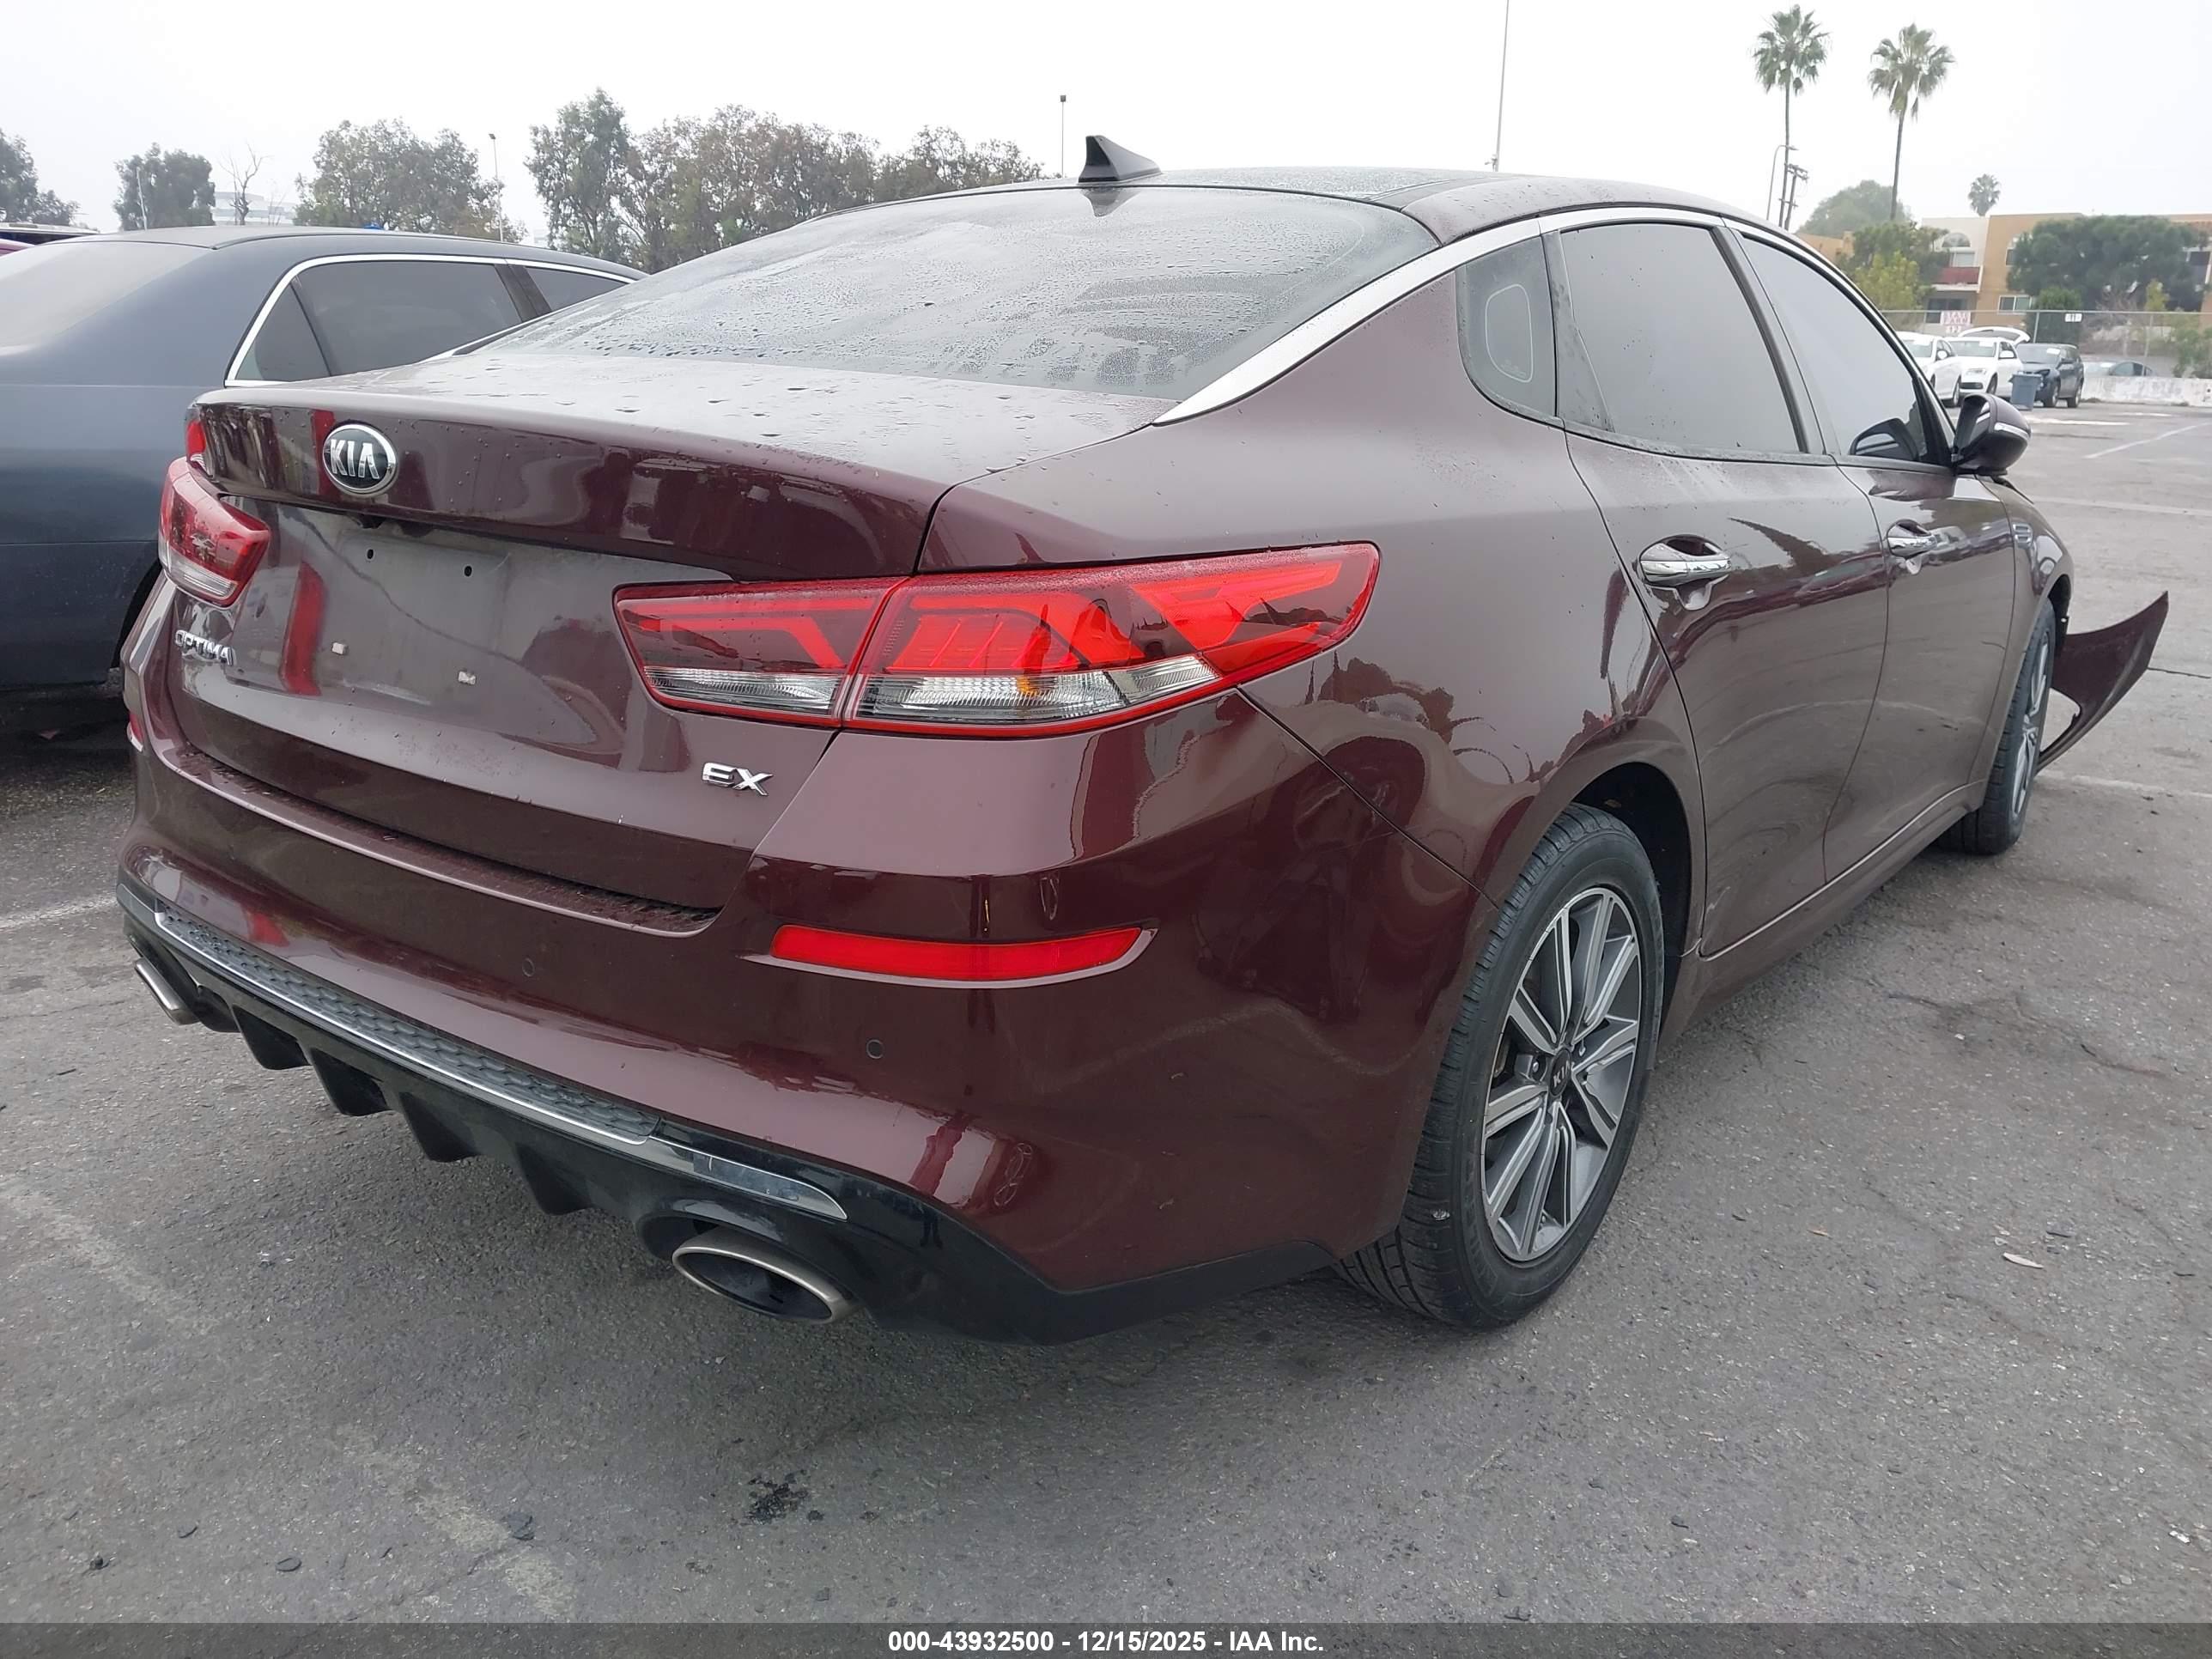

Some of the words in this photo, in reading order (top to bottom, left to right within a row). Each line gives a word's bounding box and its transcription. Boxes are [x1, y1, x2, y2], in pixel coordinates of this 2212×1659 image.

[330, 439, 380, 480] KIA
[174, 629, 234, 666] OPTIMA
[702, 762, 775, 797] EX
[1553, 1060, 1571, 1088] KIA
